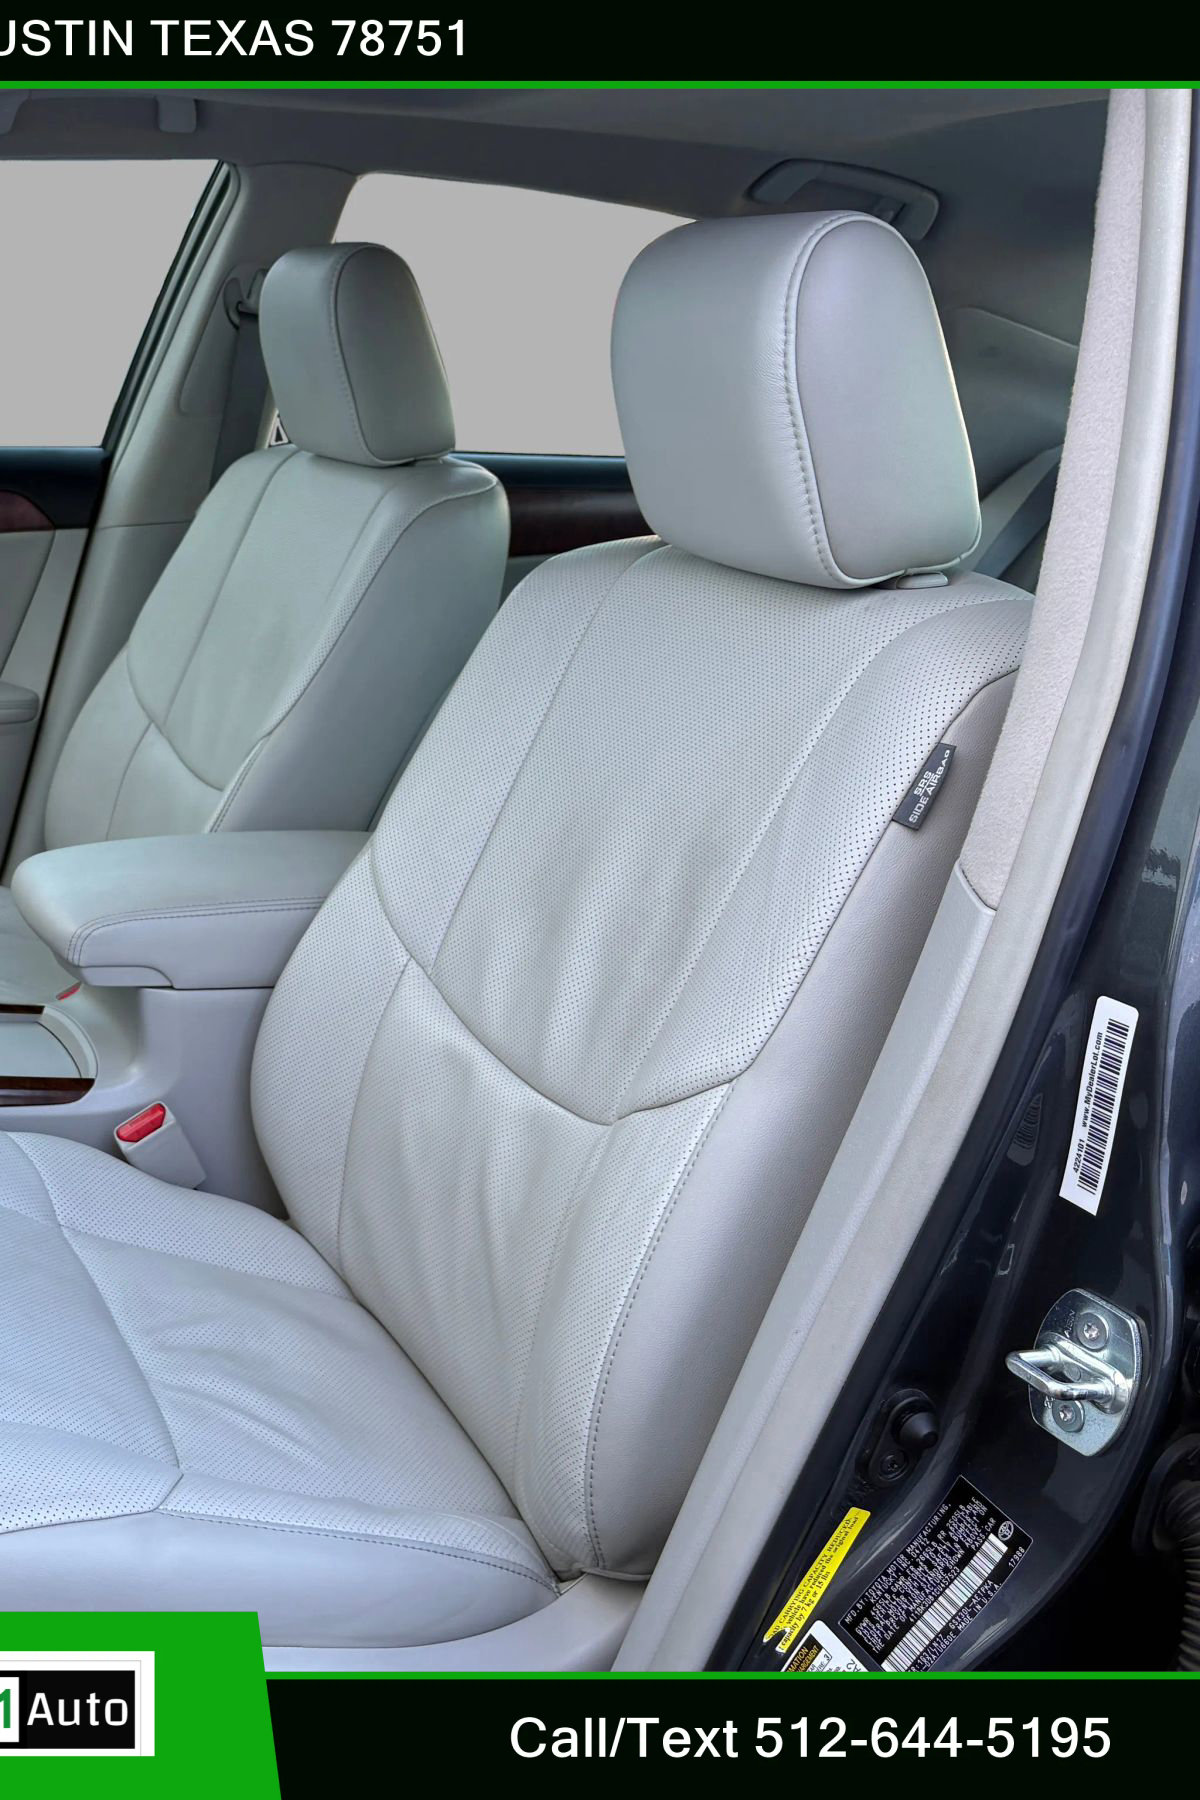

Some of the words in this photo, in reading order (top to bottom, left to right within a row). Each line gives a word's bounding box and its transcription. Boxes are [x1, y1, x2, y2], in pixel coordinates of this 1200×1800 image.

[909, 795, 929, 823] SIDE
[926, 749, 951, 796] AIRBAG
[914, 771, 932, 796] SRS
[1073, 1138, 1085, 1174] 4224101
[1082, 1031, 1103, 1128] www.MyDealerLot.com
[854, 1616, 870, 1634] GVWR
[890, 1575, 906, 1592] GAWR
[936, 1529, 946, 1540] RR
[885, 1588, 919, 1626] PREVENTION
[919, 1553, 951, 1588] STANDARDS
[886, 1553, 906, 1574] MOTOR
[780, 1621, 798, 1646] capacity
[795, 1611, 803, 1622] by
[804, 1597, 813, 1607] kg
[815, 1579, 824, 1589] 15
[872, 1640, 884, 1653] THE
[883, 1622, 899, 1640] DATE
[898, 1611, 908, 1622] OF
[907, 1569, 946, 1612] MANUFACTURE
[946, 1547, 964, 1569] SHOWN
[873, 1593, 898, 1622] VEHICLE
[956, 1613, 973, 1631] MADE
[972, 1603, 982, 1612] IN
[980, 1579, 1002, 1603] U.S.A.
